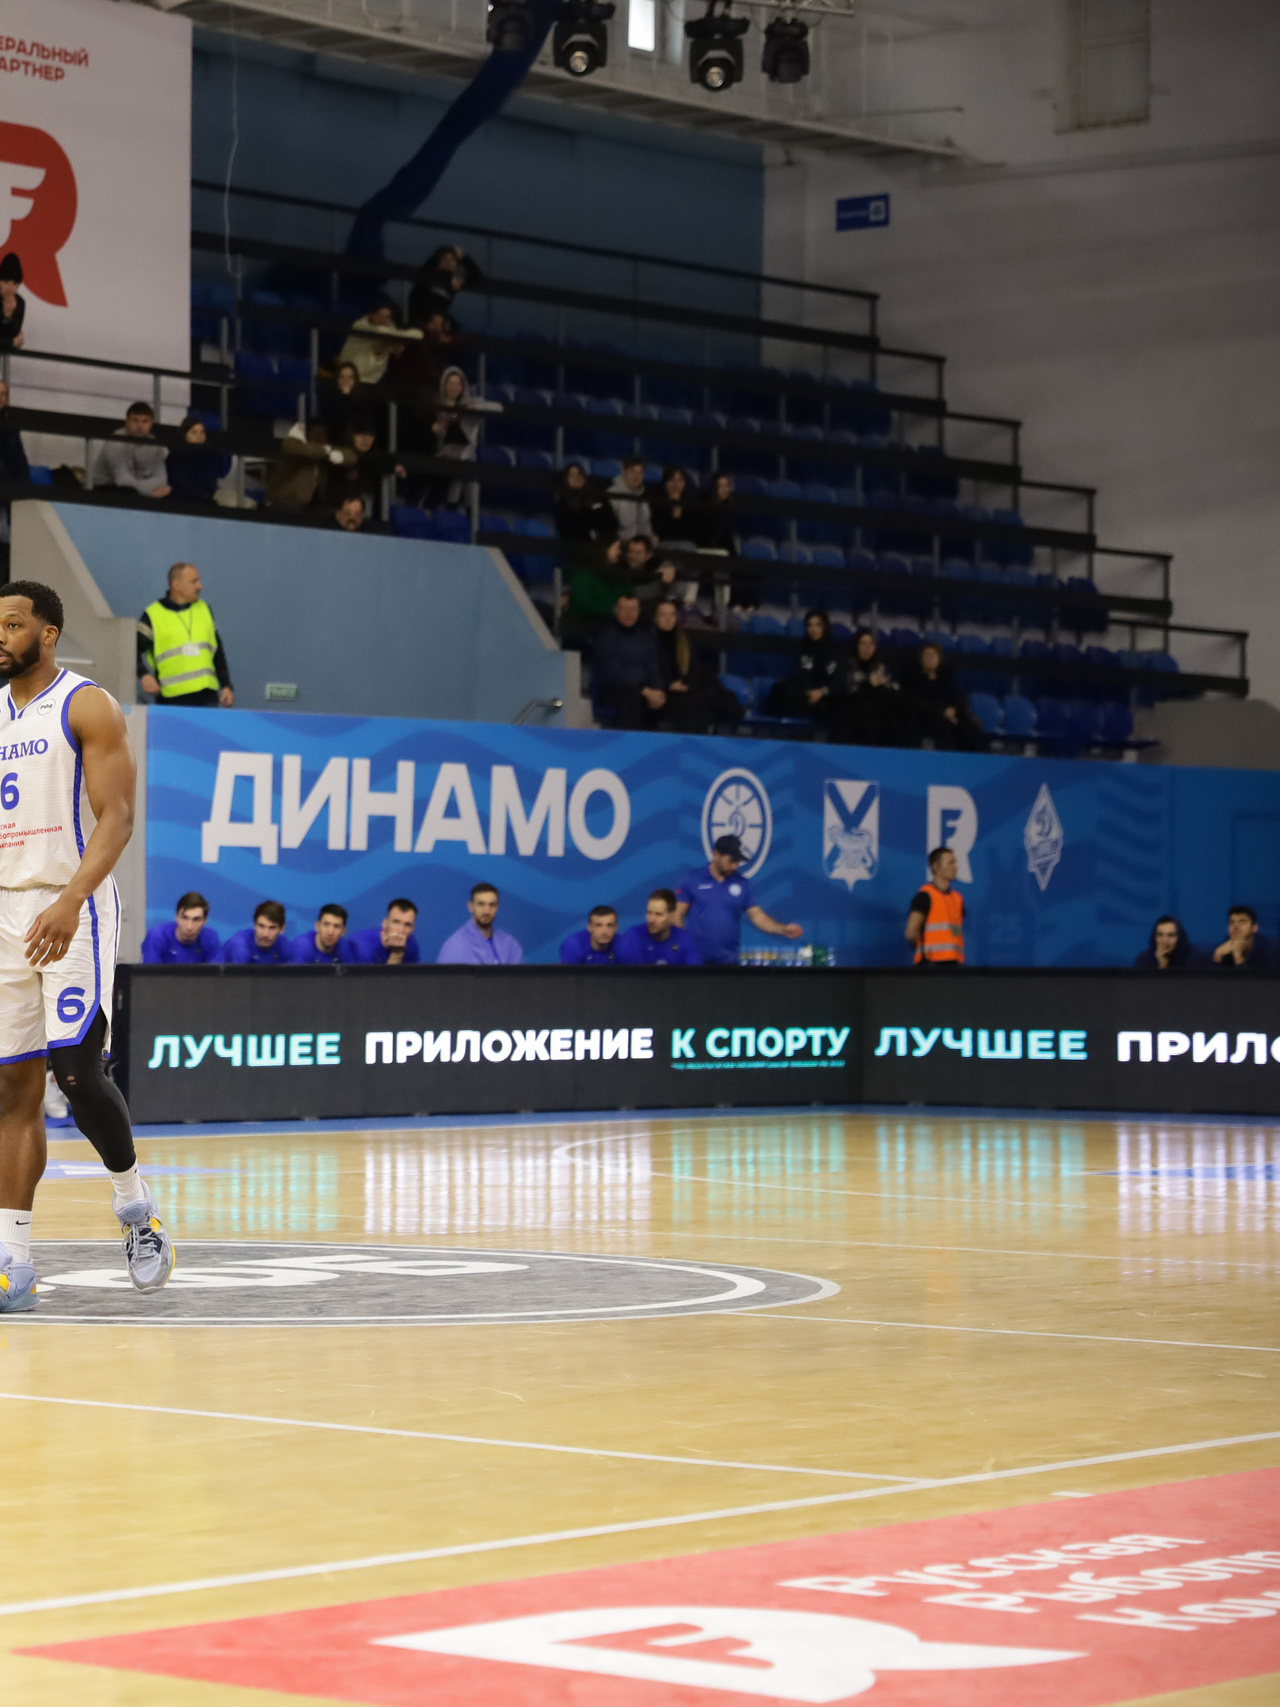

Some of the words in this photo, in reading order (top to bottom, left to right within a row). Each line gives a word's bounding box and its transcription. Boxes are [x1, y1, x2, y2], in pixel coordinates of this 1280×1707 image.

[0, 772, 20, 811] 6
[201, 751, 631, 865] ДИНАМО
[57, 986, 85, 1023] 6
[148, 1032, 341, 1069] ЛУЧШЕЕ
[365, 1027, 654, 1065] ПРИЛОЖЕНИЕ
[671, 1028, 696, 1058] К
[705, 1027, 851, 1058] СПОРТУ
[874, 1027, 1088, 1060] ЛУЧШЕЕ
[1117, 1031, 1280, 1065] ПРИЛ
[776, 1533, 1207, 1597] Русская
